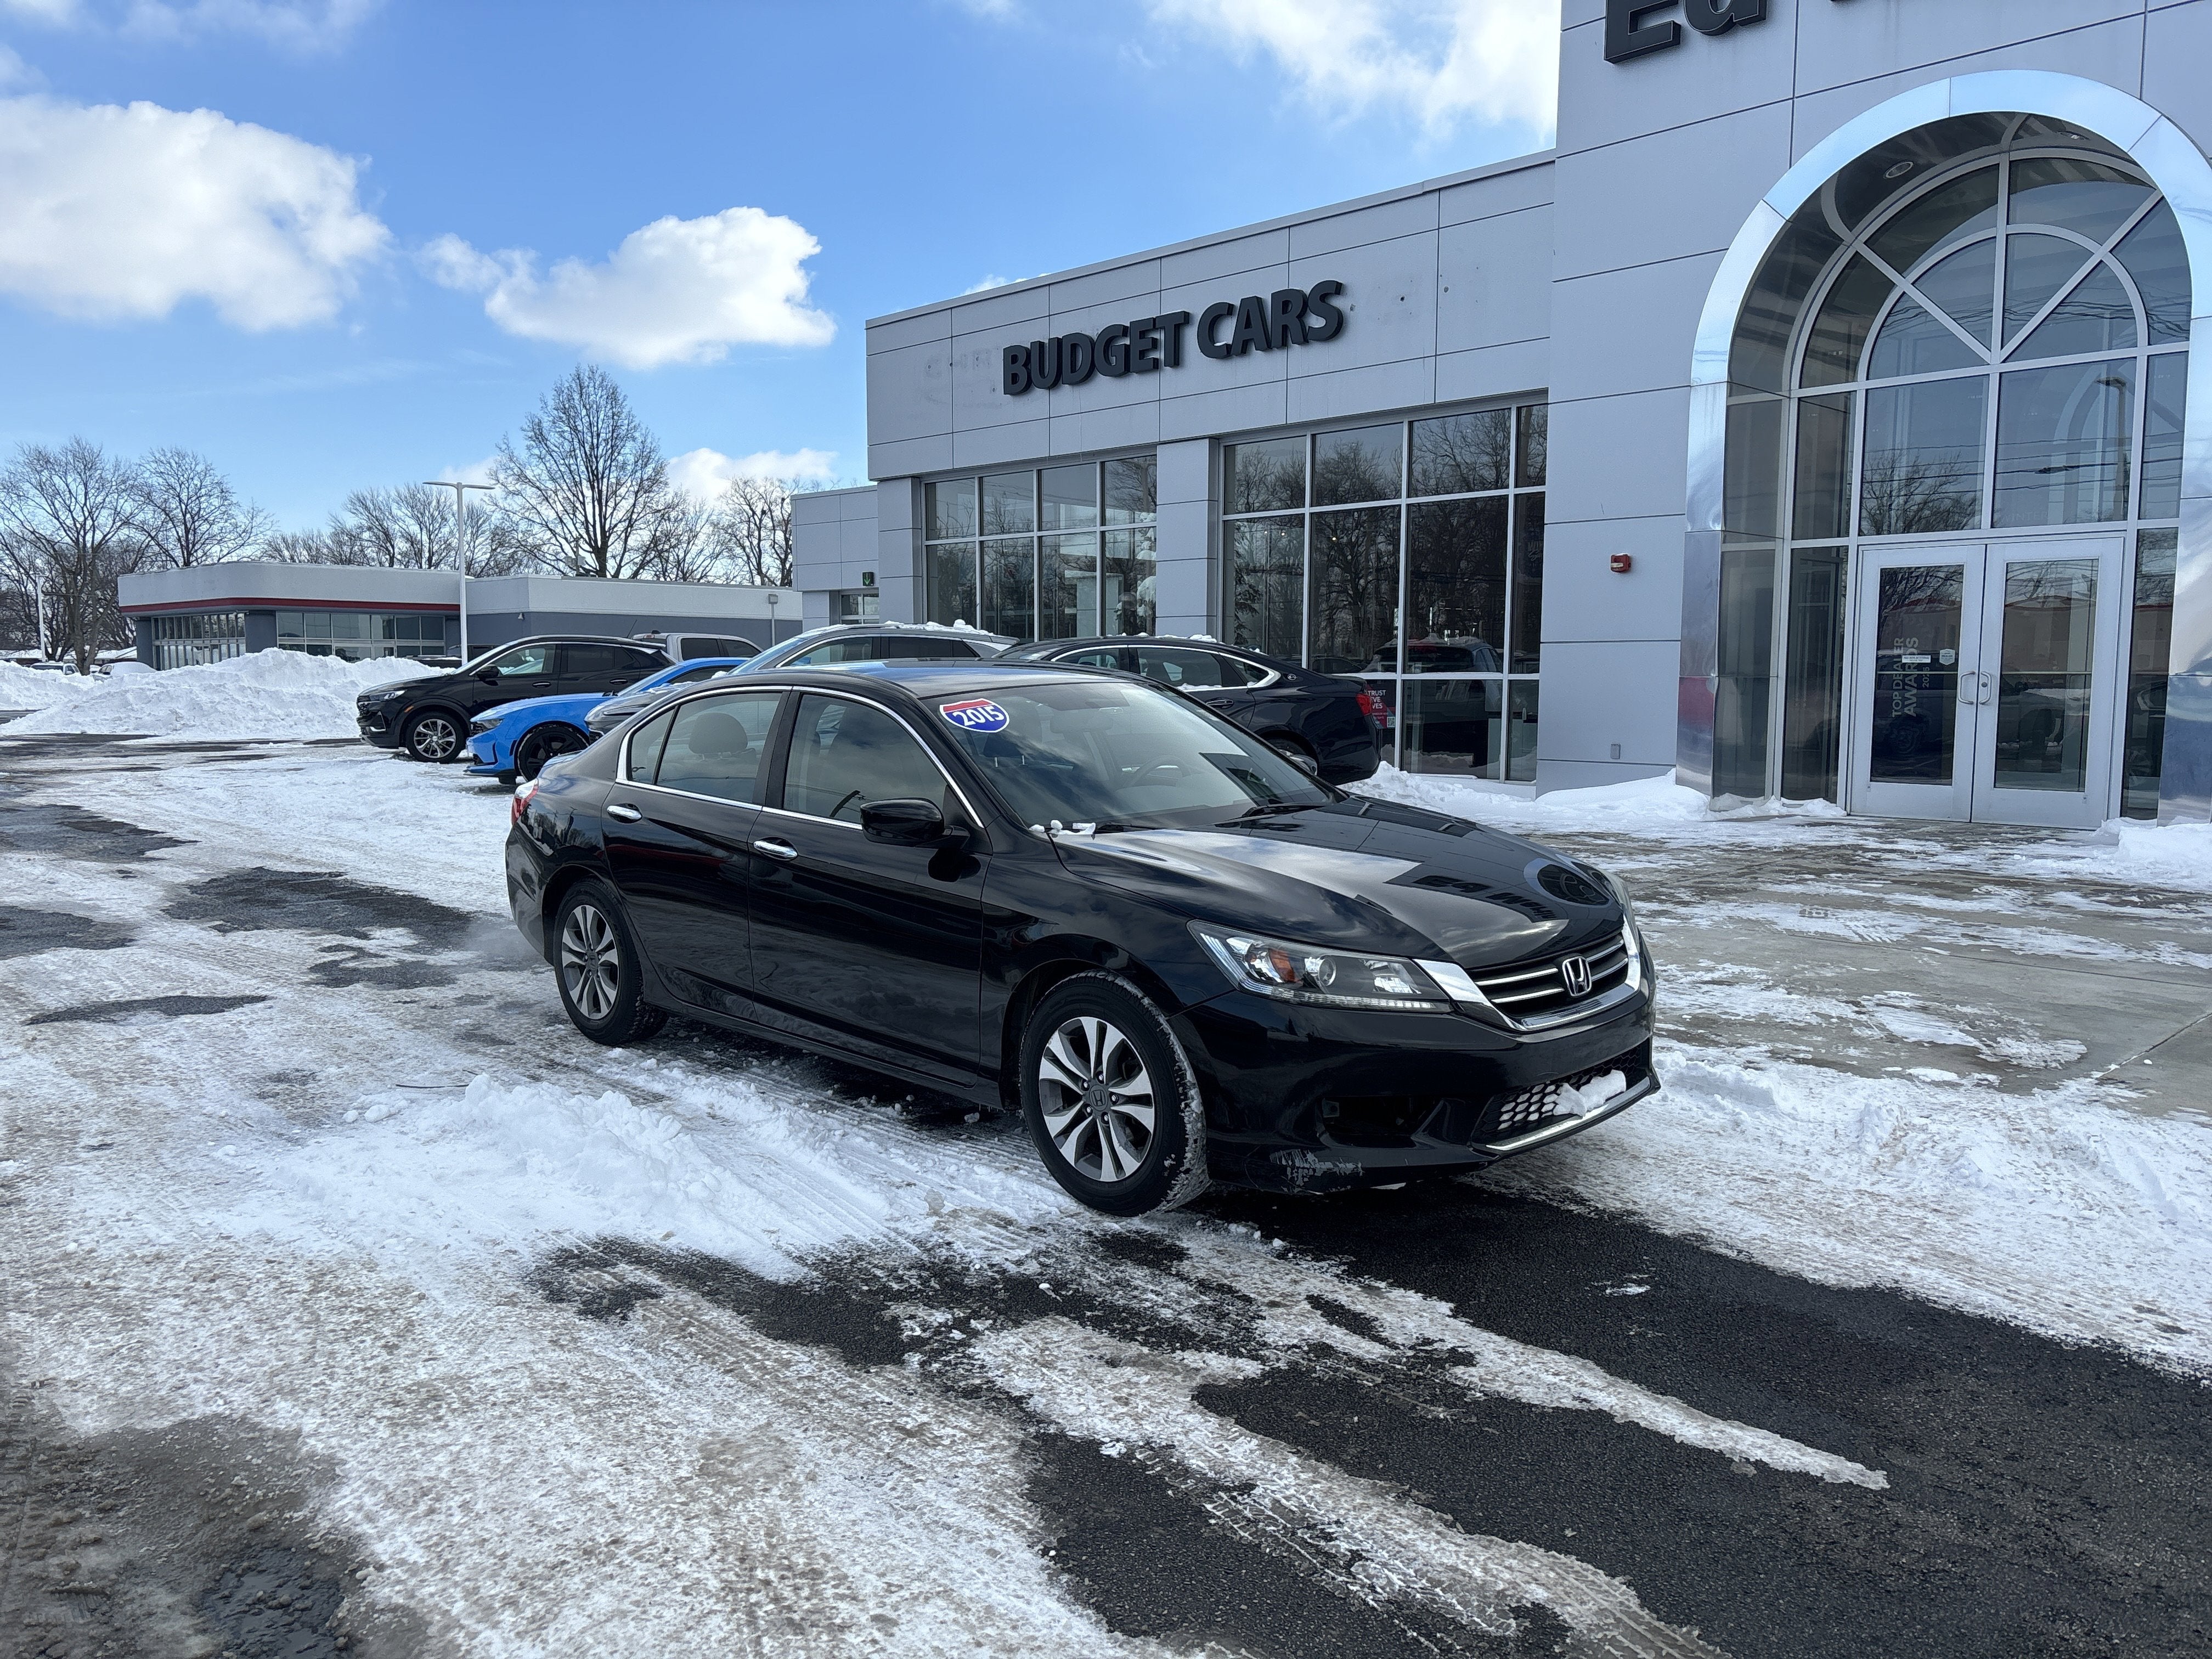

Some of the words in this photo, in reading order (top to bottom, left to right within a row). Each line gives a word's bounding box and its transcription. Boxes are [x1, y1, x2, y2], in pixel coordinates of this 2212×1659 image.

[1002, 311, 1192, 396] BUDGET
[1197, 280, 1344, 360] CARS
[952, 706, 1005, 726] 2015
[1892, 692, 1902, 718] TOP
